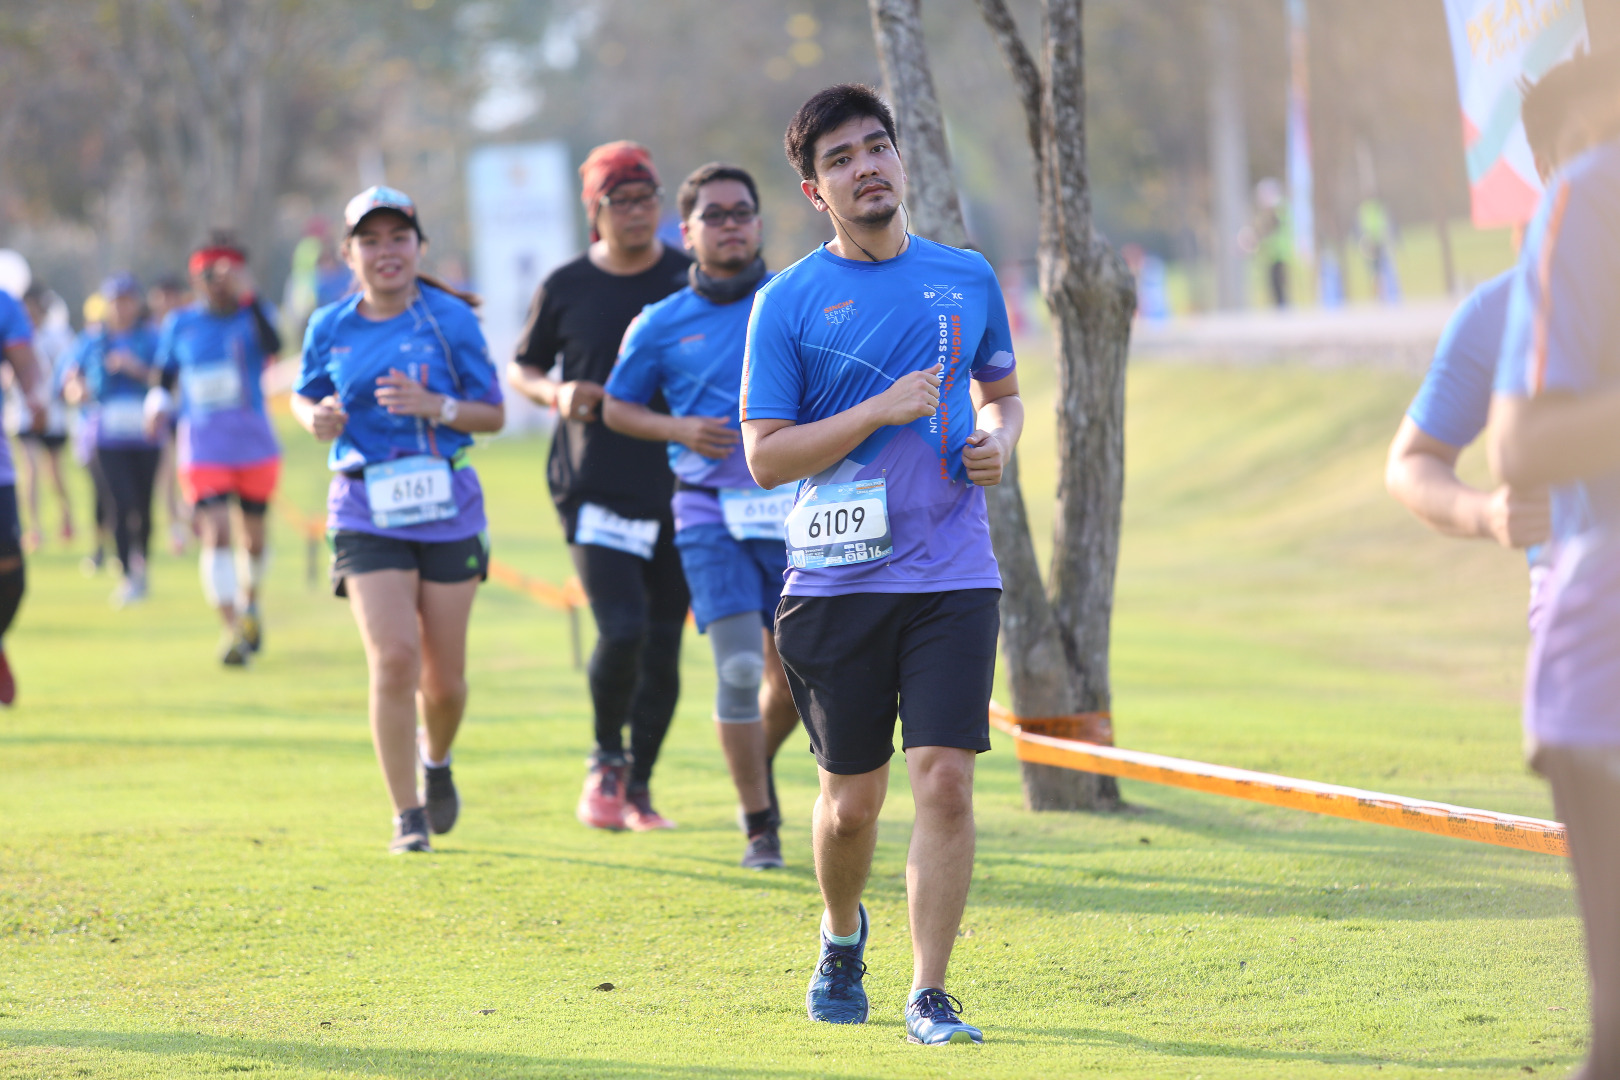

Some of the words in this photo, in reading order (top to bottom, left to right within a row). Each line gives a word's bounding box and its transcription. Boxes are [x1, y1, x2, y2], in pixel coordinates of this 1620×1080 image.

[823, 299, 855, 314] SINGHA
[923, 291, 936, 299] SP
[951, 292, 964, 300] XC
[938, 314, 948, 352] CROSS
[951, 314, 962, 364] SINGHA
[940, 402, 950, 454] CHIANG
[393, 475, 434, 503] 6161
[808, 506, 866, 538] 6109
[868, 545, 882, 559] 16
